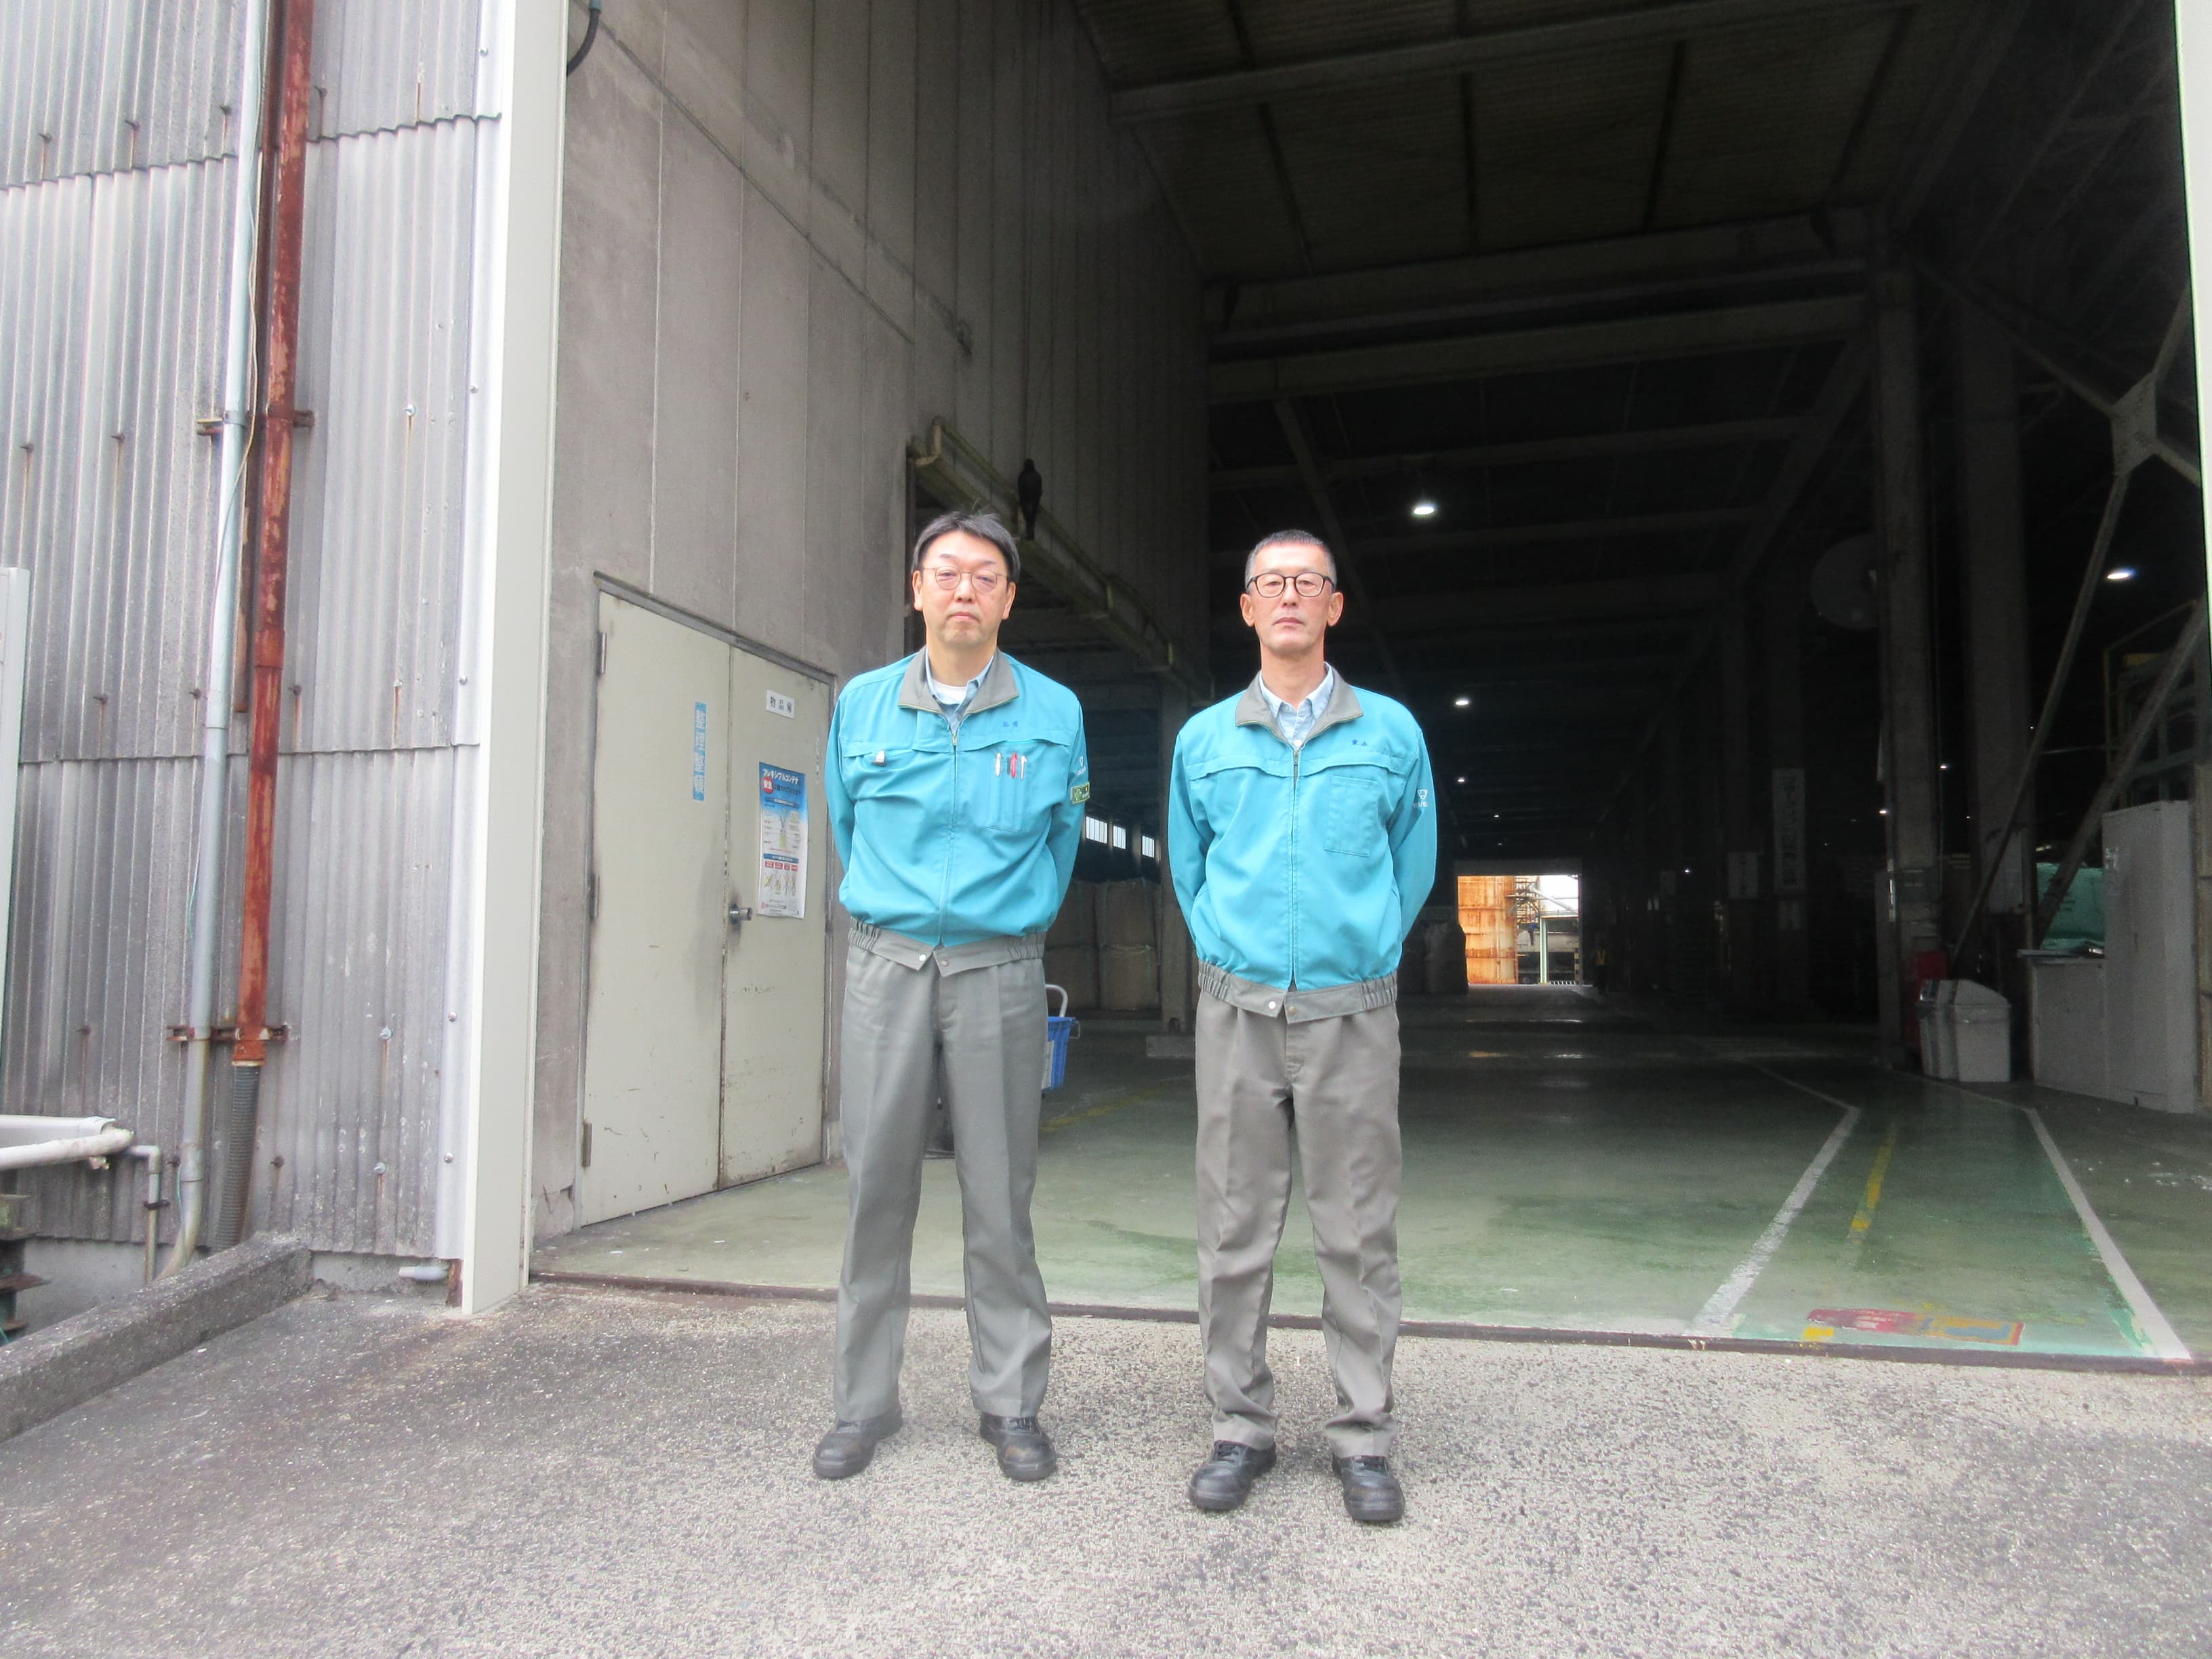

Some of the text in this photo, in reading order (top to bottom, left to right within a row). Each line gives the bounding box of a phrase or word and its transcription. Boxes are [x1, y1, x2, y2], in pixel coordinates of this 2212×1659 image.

[770, 696, 792, 713] 物品庫
[693, 709, 706, 793] 整理整頓
